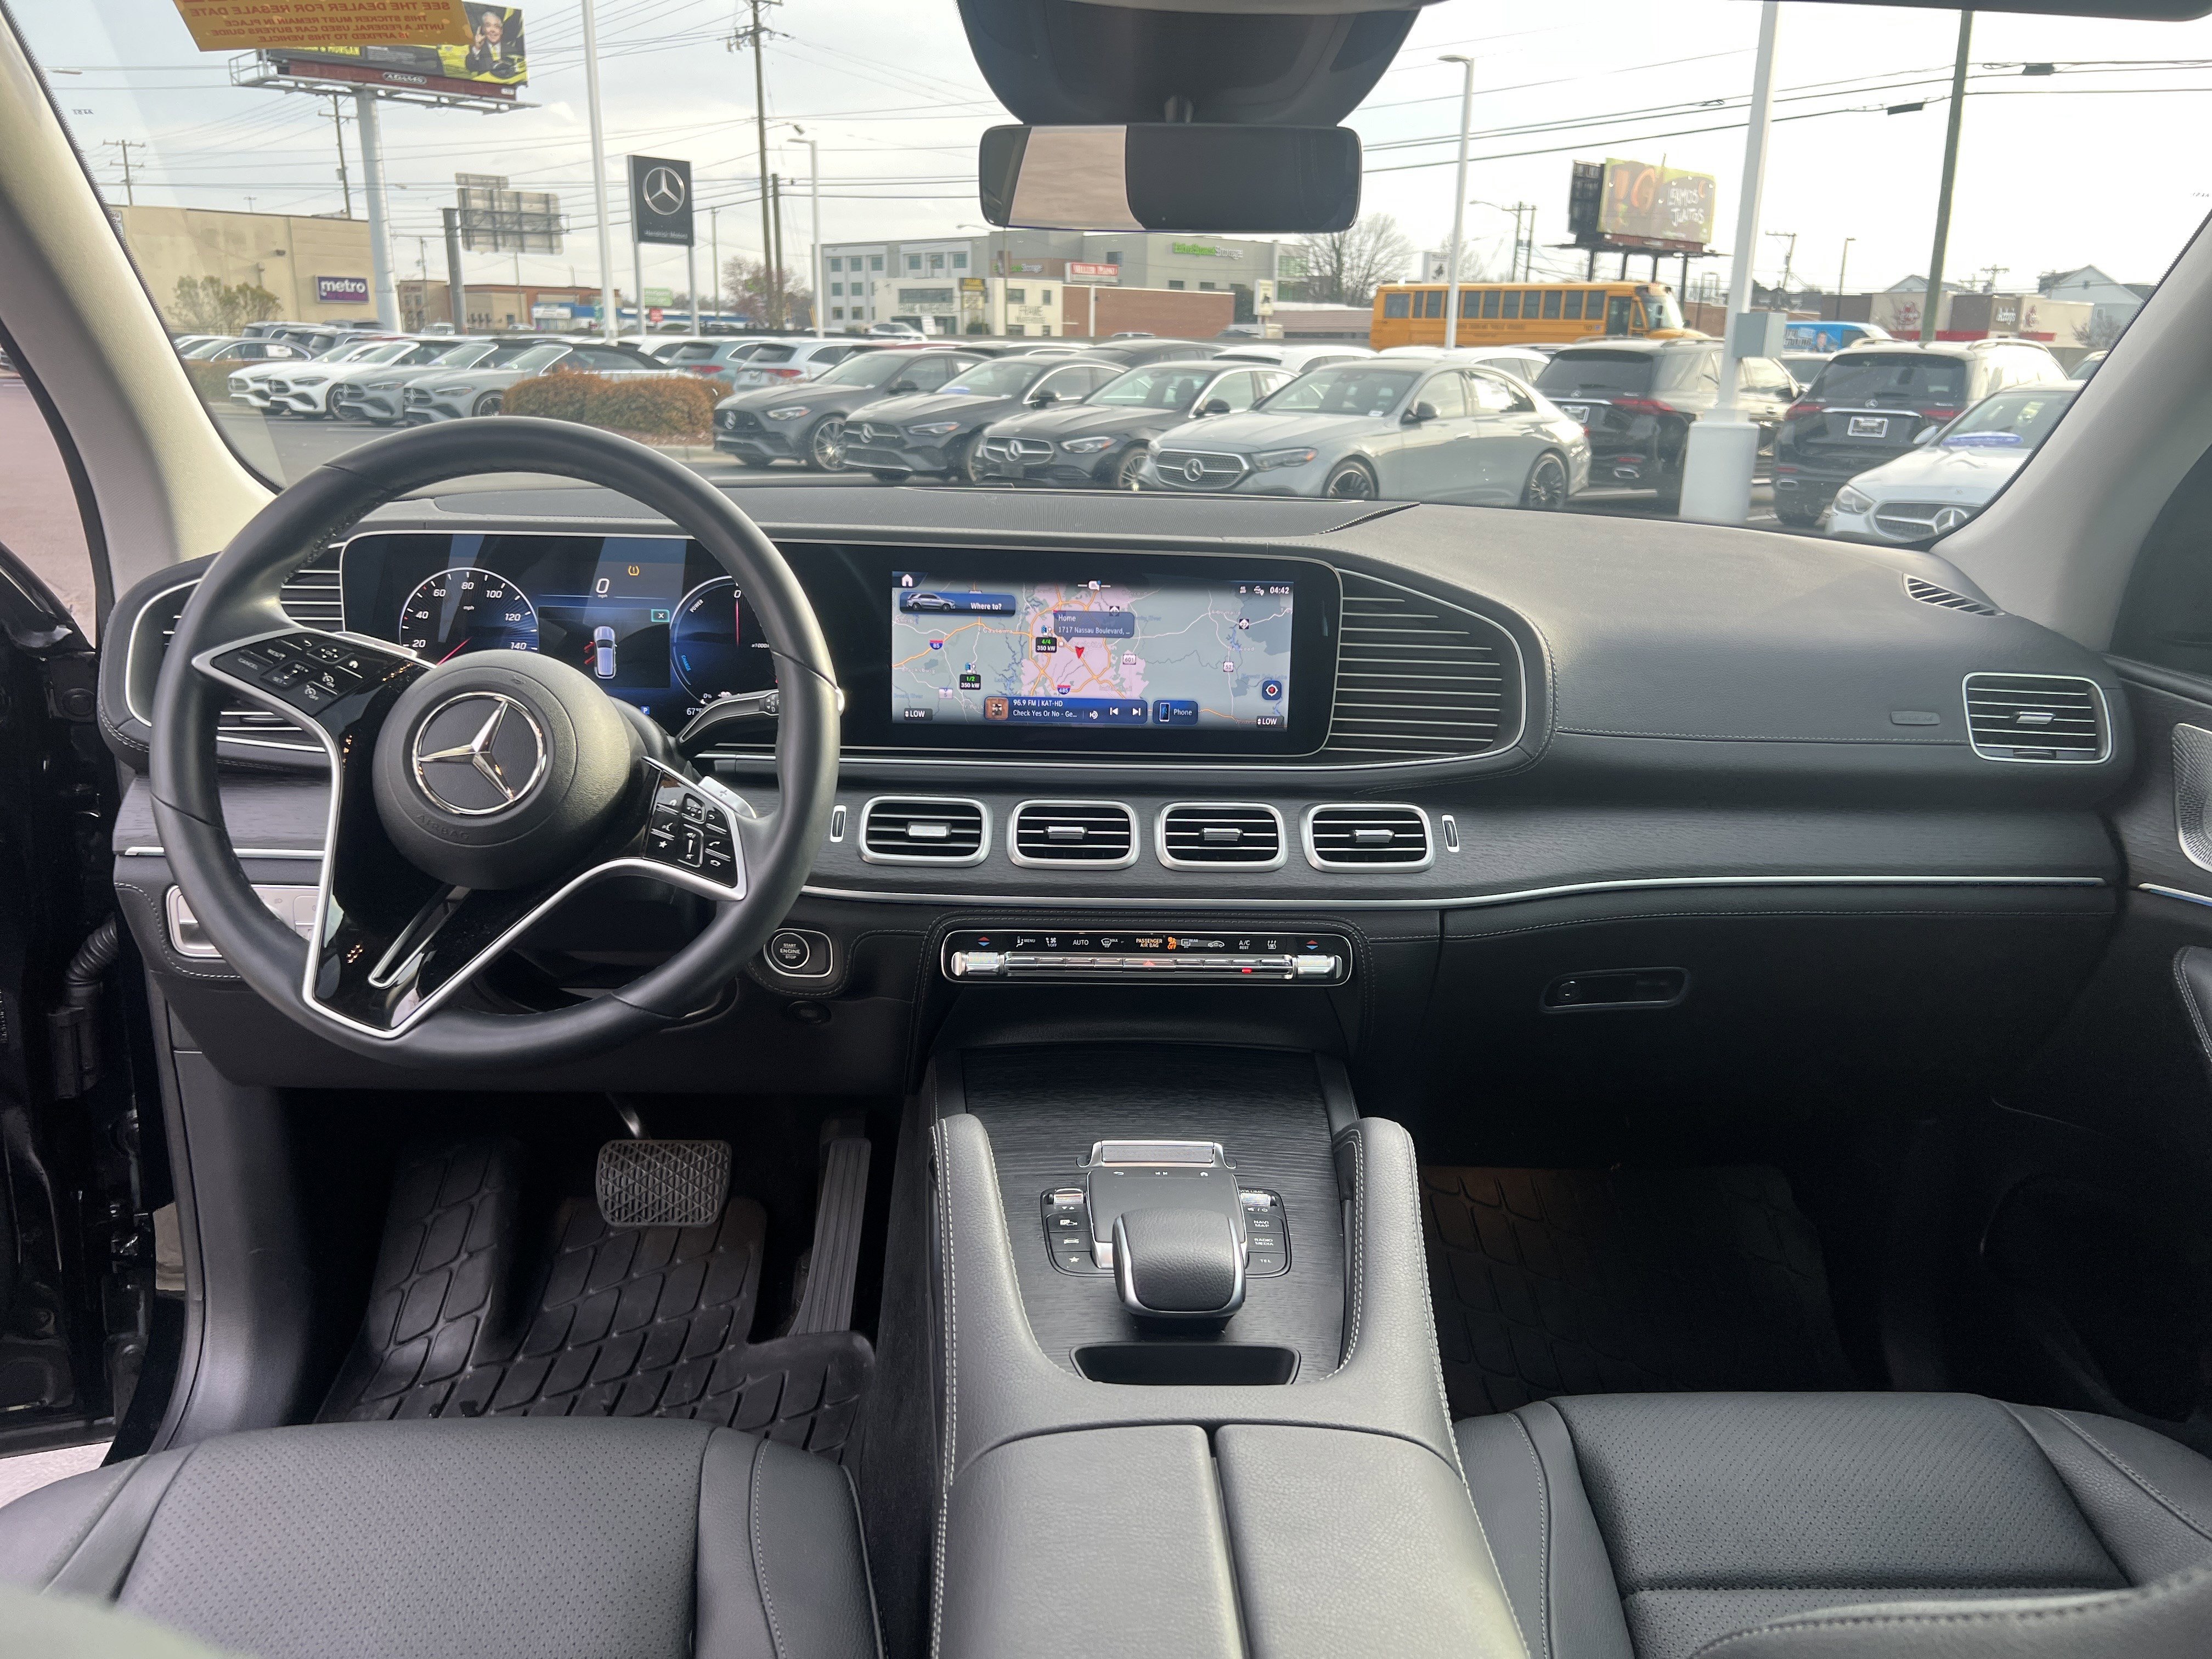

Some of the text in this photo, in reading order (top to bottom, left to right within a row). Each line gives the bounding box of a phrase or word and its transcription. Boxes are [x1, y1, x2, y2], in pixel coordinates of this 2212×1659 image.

[320, 279, 366, 295] metro
[1996, 307, 2016, 325] Arby's
[596, 578, 610, 593] 0
[734, 590, 741, 598] 0
[690, 599, 704, 613] POWER
[238, 658, 258, 670] CANCEL
